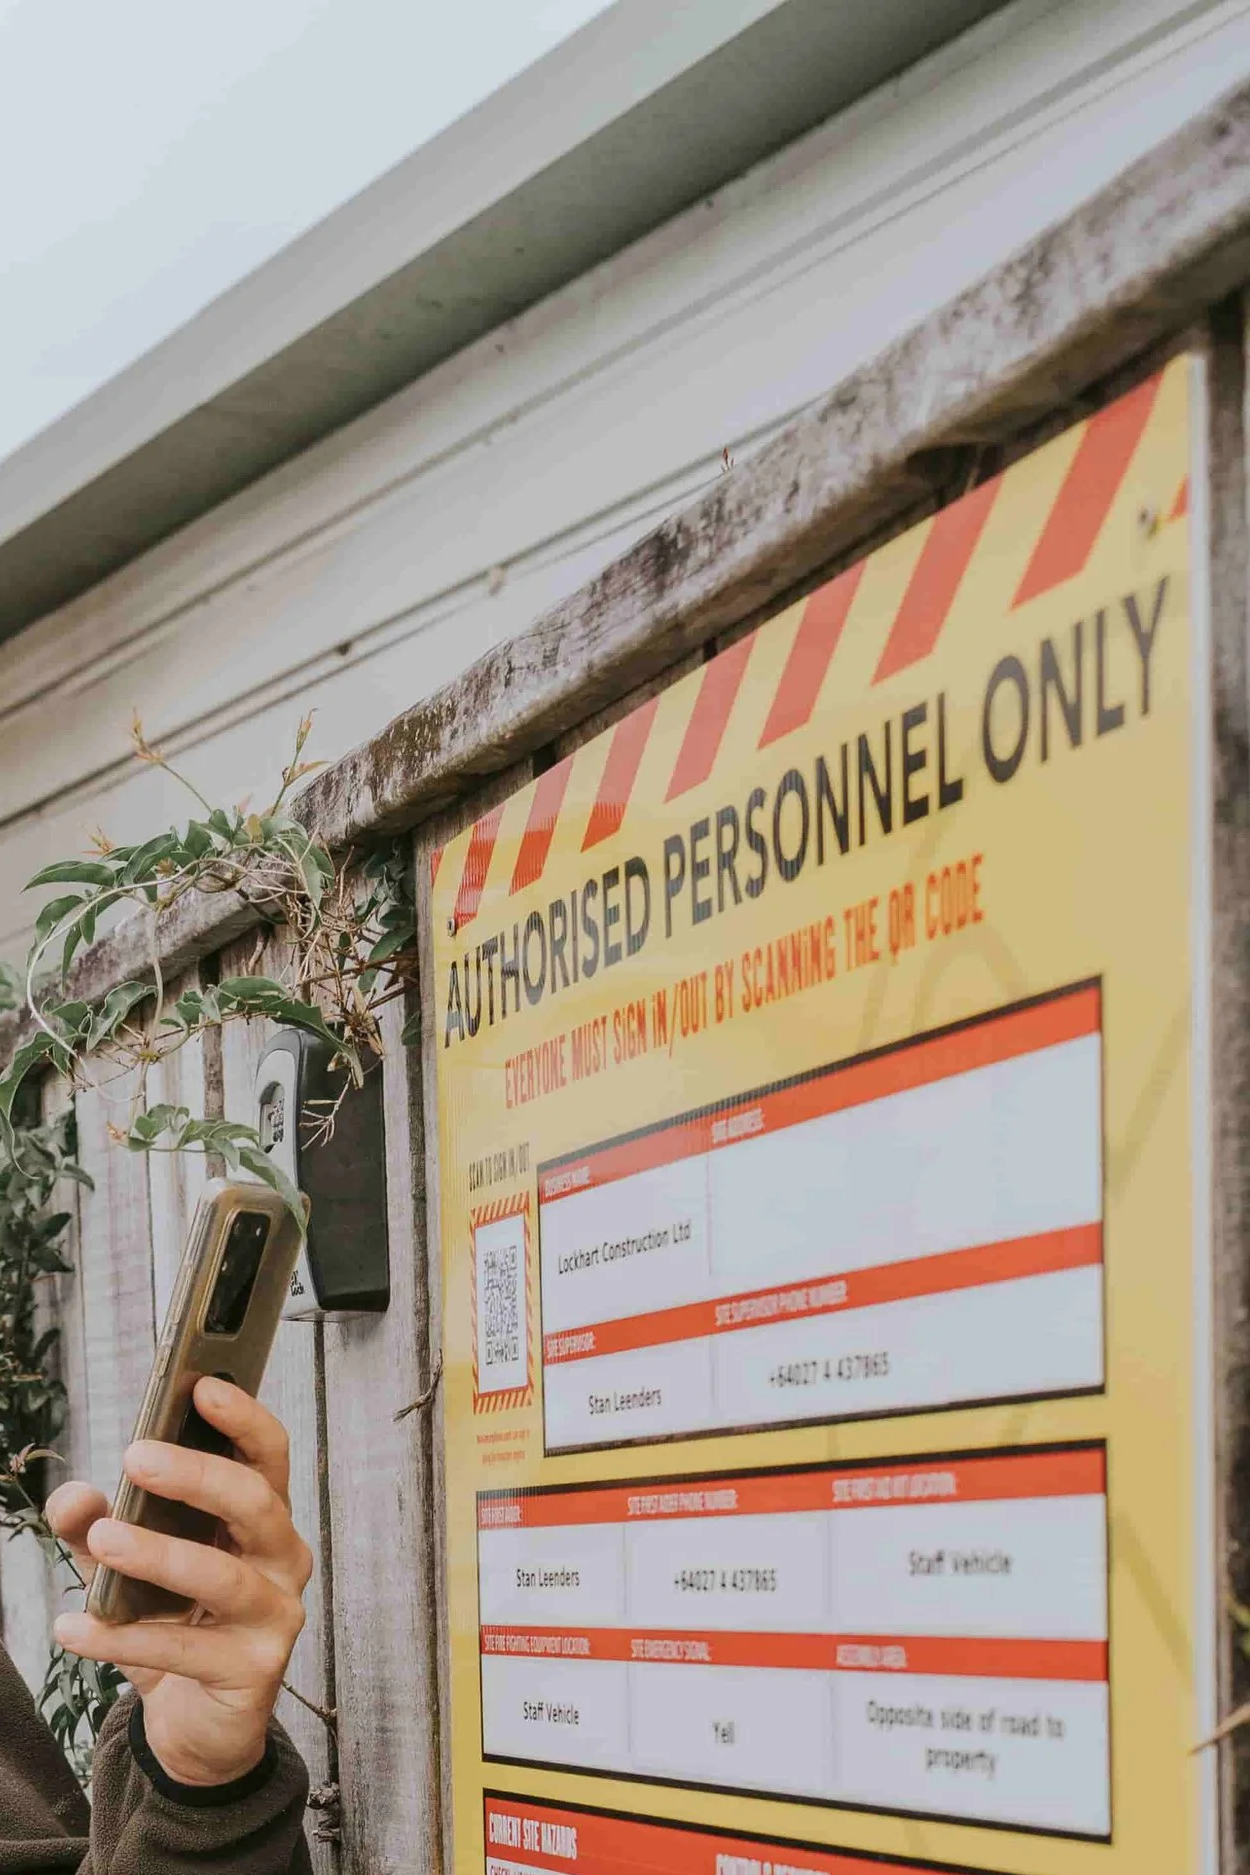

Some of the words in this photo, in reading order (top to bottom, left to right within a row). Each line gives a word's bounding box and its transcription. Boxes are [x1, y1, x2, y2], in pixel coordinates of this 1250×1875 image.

[445, 855, 649, 1048] AUTHORISED
[665, 692, 964, 938] PERSONNEL
[981, 574, 1171, 785] ONLY
[505, 1045, 567, 1109] EVERYONE
[572, 1015, 608, 1075] MUST
[714, 959, 734, 1024] BY
[843, 898, 880, 973] THE
[888, 880, 916, 966] QR
[924, 853, 985, 941] CODE
[558, 1247, 599, 1275] Lockhart
[602, 1228, 670, 1263] Construction
[672, 1218, 692, 1244] Ltd
[589, 1393, 611, 1415] Stan
[614, 1388, 662, 1412] Leenders
[516, 1567, 536, 1588] Stan
[538, 1567, 580, 1589] Leenders
[908, 1550, 946, 1577] Staff
[523, 1701, 544, 1722] Staff
[547, 1703, 579, 1726] Vehicle
[523, 1818, 540, 1853] SITE
[541, 1822, 578, 1860] HAZARDS
